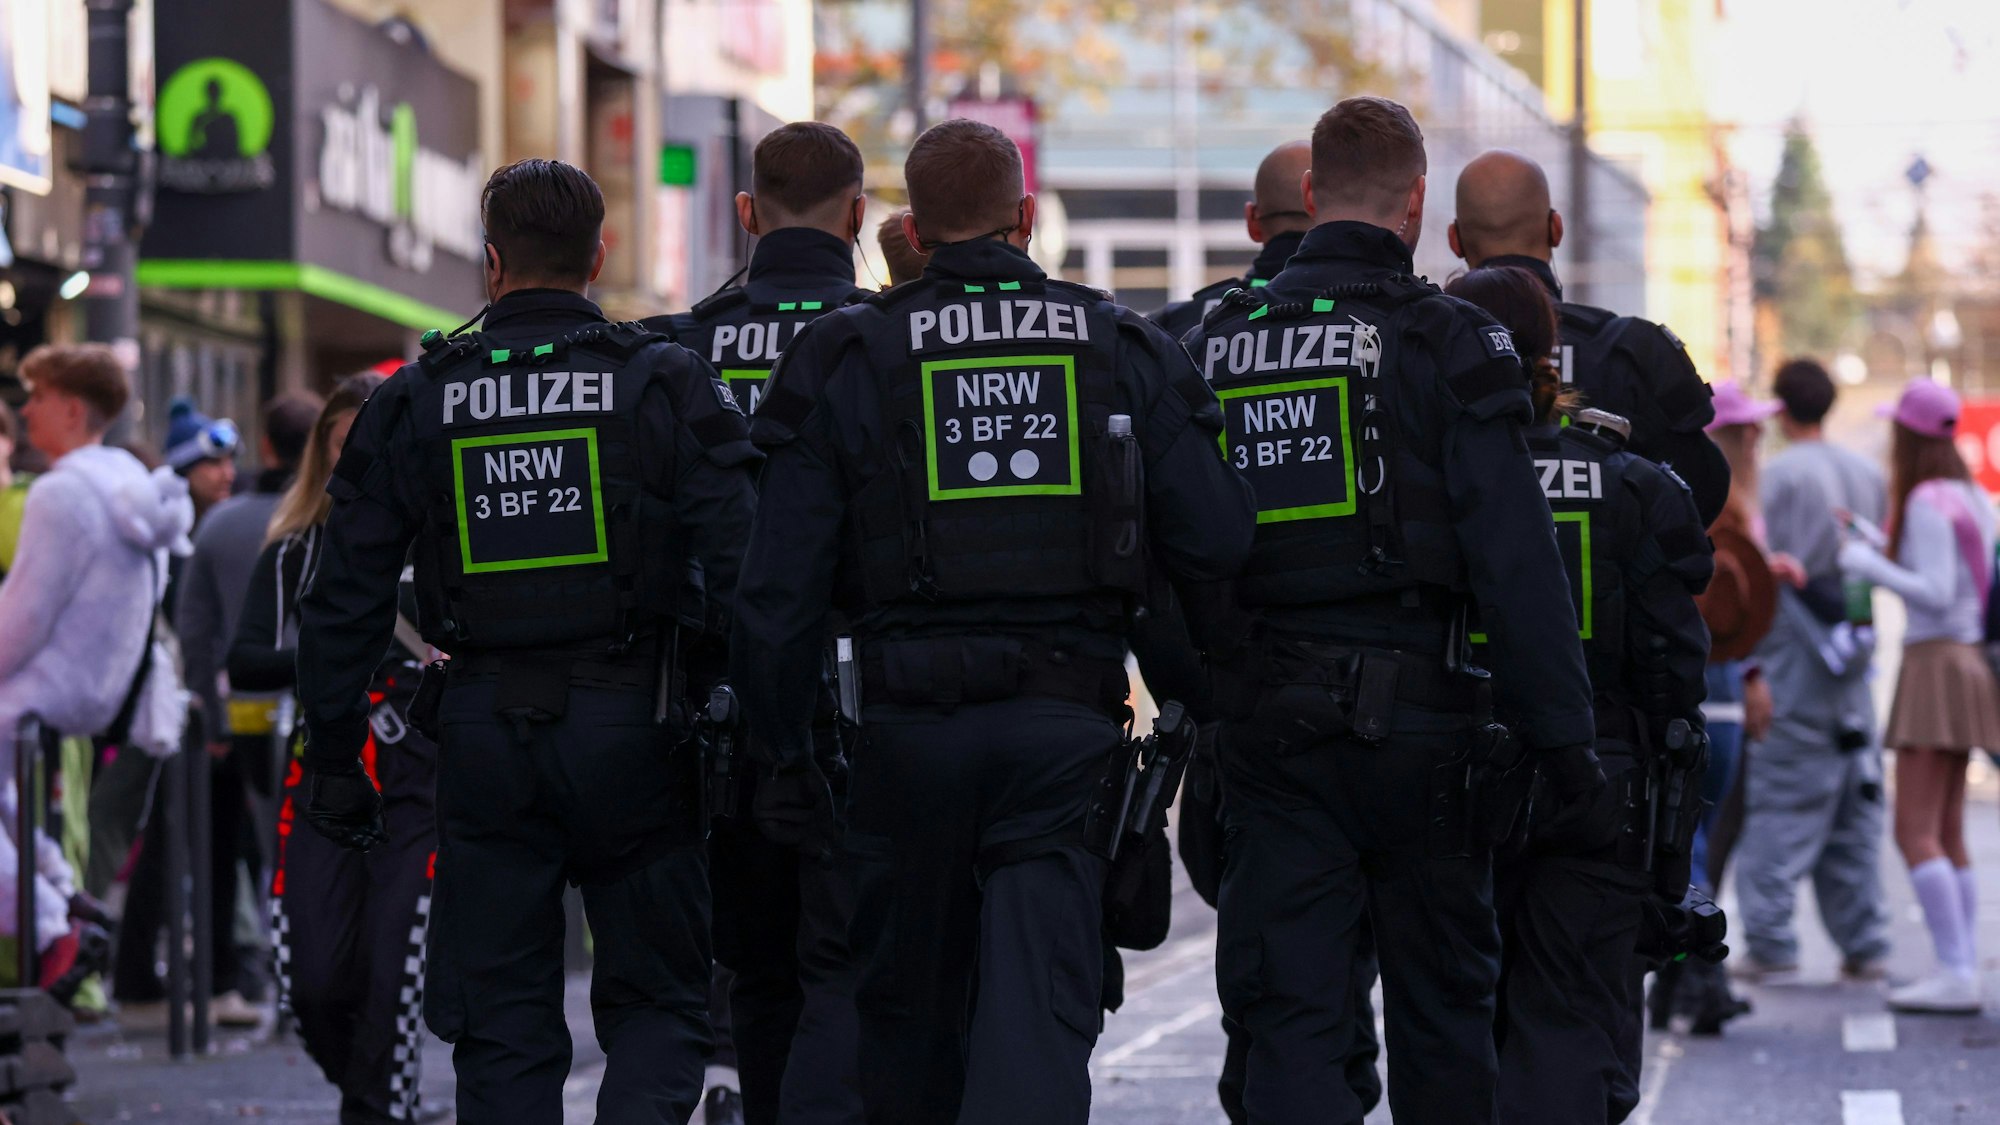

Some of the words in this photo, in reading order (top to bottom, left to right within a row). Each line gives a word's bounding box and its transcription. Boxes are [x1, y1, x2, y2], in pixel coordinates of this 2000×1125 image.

[910, 300, 1088, 350] POLIZEI
[442, 372, 613, 424] POLIZEI
[957, 371, 1040, 408] NRW
[945, 418, 962, 444] 3
[972, 414, 1013, 442] BF
[1023, 413, 1058, 440] 22
[1243, 394, 1317, 435] NRW
[484, 446, 564, 485] NRW
[1234, 444, 1249, 470] 3
[1256, 439, 1292, 467] BF
[1300, 435, 1333, 462] 22
[1534, 459, 1603, 499] ZEI
[475, 494, 491, 520] 3
[500, 490, 538, 517] BF
[547, 486, 582, 513] 22
